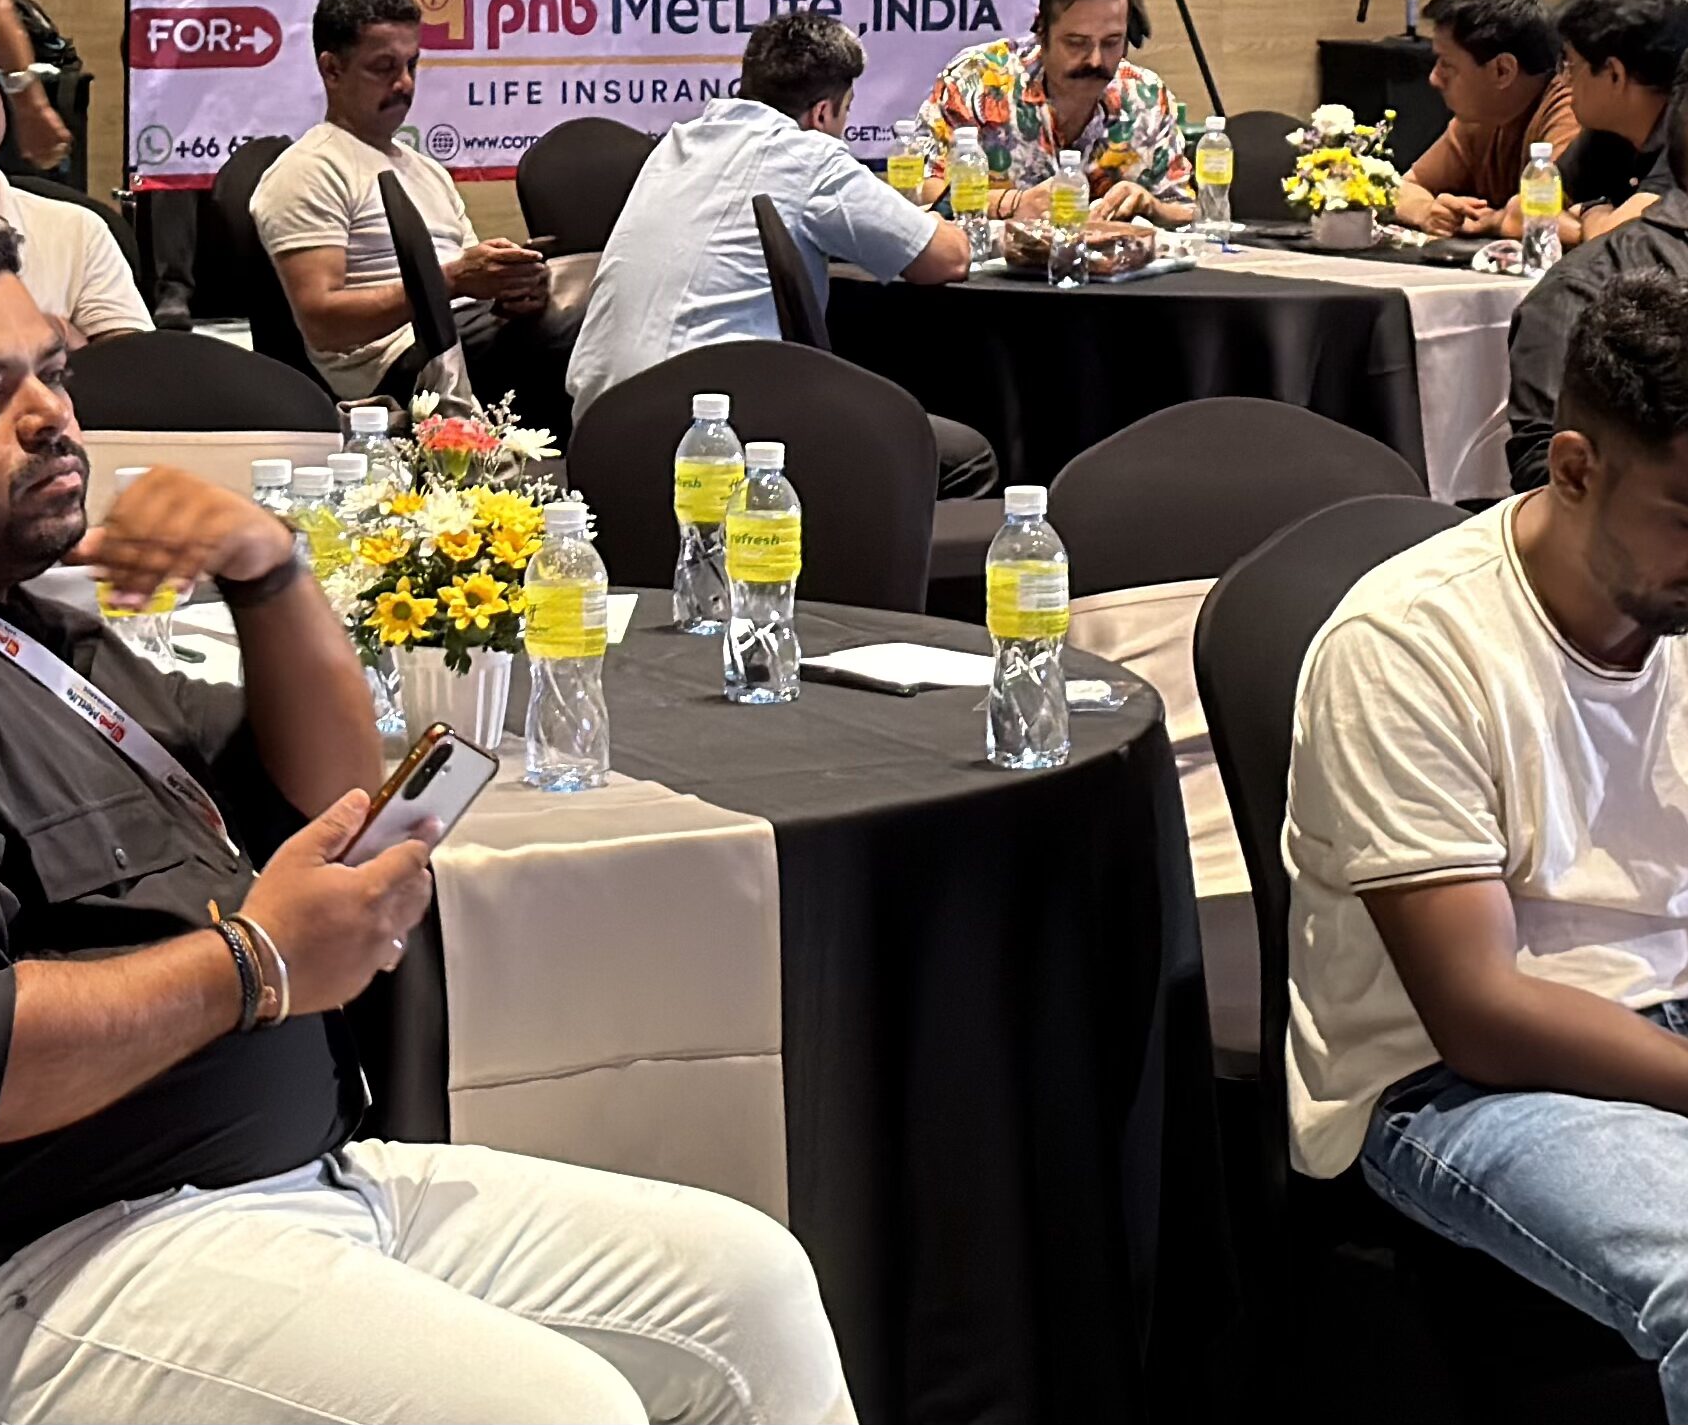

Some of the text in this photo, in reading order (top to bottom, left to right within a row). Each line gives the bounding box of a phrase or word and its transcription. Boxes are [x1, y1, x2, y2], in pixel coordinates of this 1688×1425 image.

[468, 78, 742, 107] LIFE INSURANC
[175, 136, 220, 158] +66
